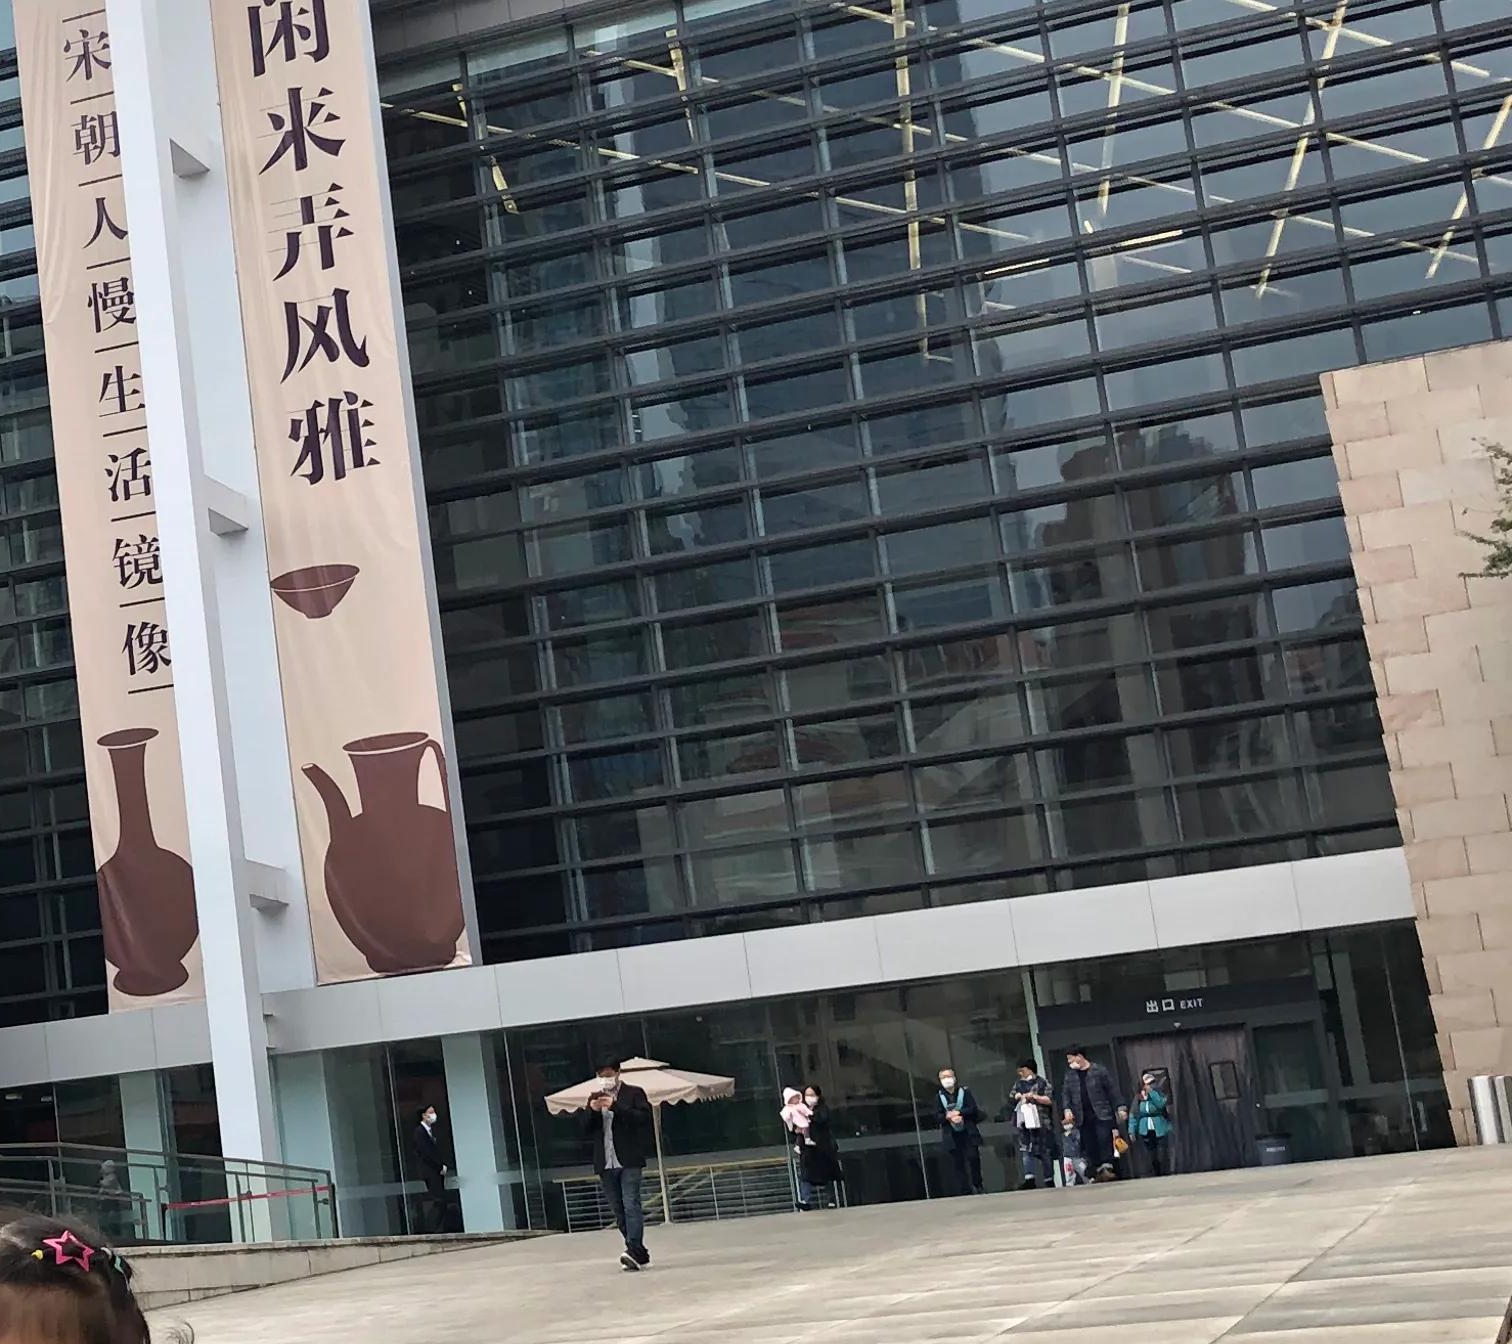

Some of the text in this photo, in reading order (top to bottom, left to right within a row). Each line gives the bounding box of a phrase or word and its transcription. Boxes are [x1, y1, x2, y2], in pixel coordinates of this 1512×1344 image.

[63, 28, 172, 676] 宋朝人慢生活镜像
[1146, 998, 1203, 1013] 出口 EXIT
